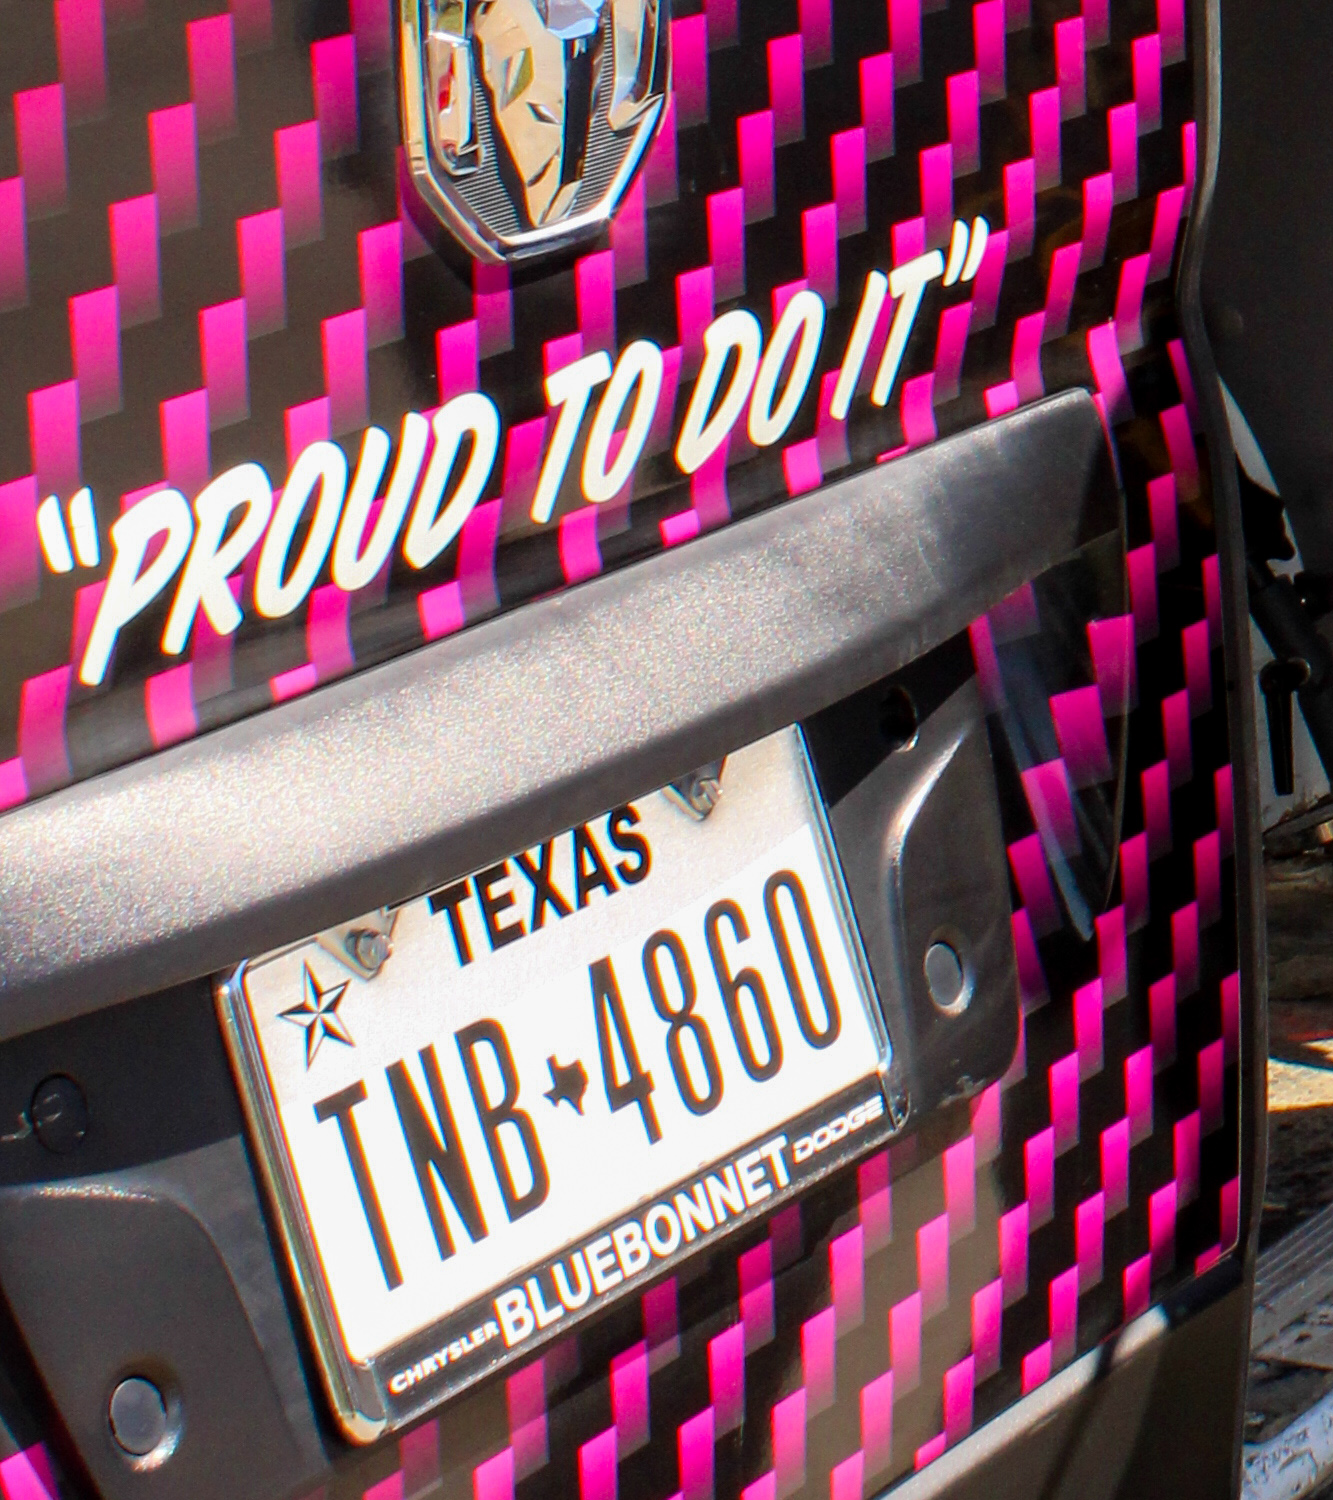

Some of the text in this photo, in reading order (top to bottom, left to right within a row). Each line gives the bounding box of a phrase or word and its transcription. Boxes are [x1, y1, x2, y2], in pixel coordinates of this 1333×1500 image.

[531, 340, 664, 524] TO
[676, 291, 826, 474] DO
[430, 803, 653, 968] TEXAS
[313, 868, 843, 1293] TNB 4860
[388, 1094, 884, 1395] CHRYSLER BLUEBONNET DODGE
